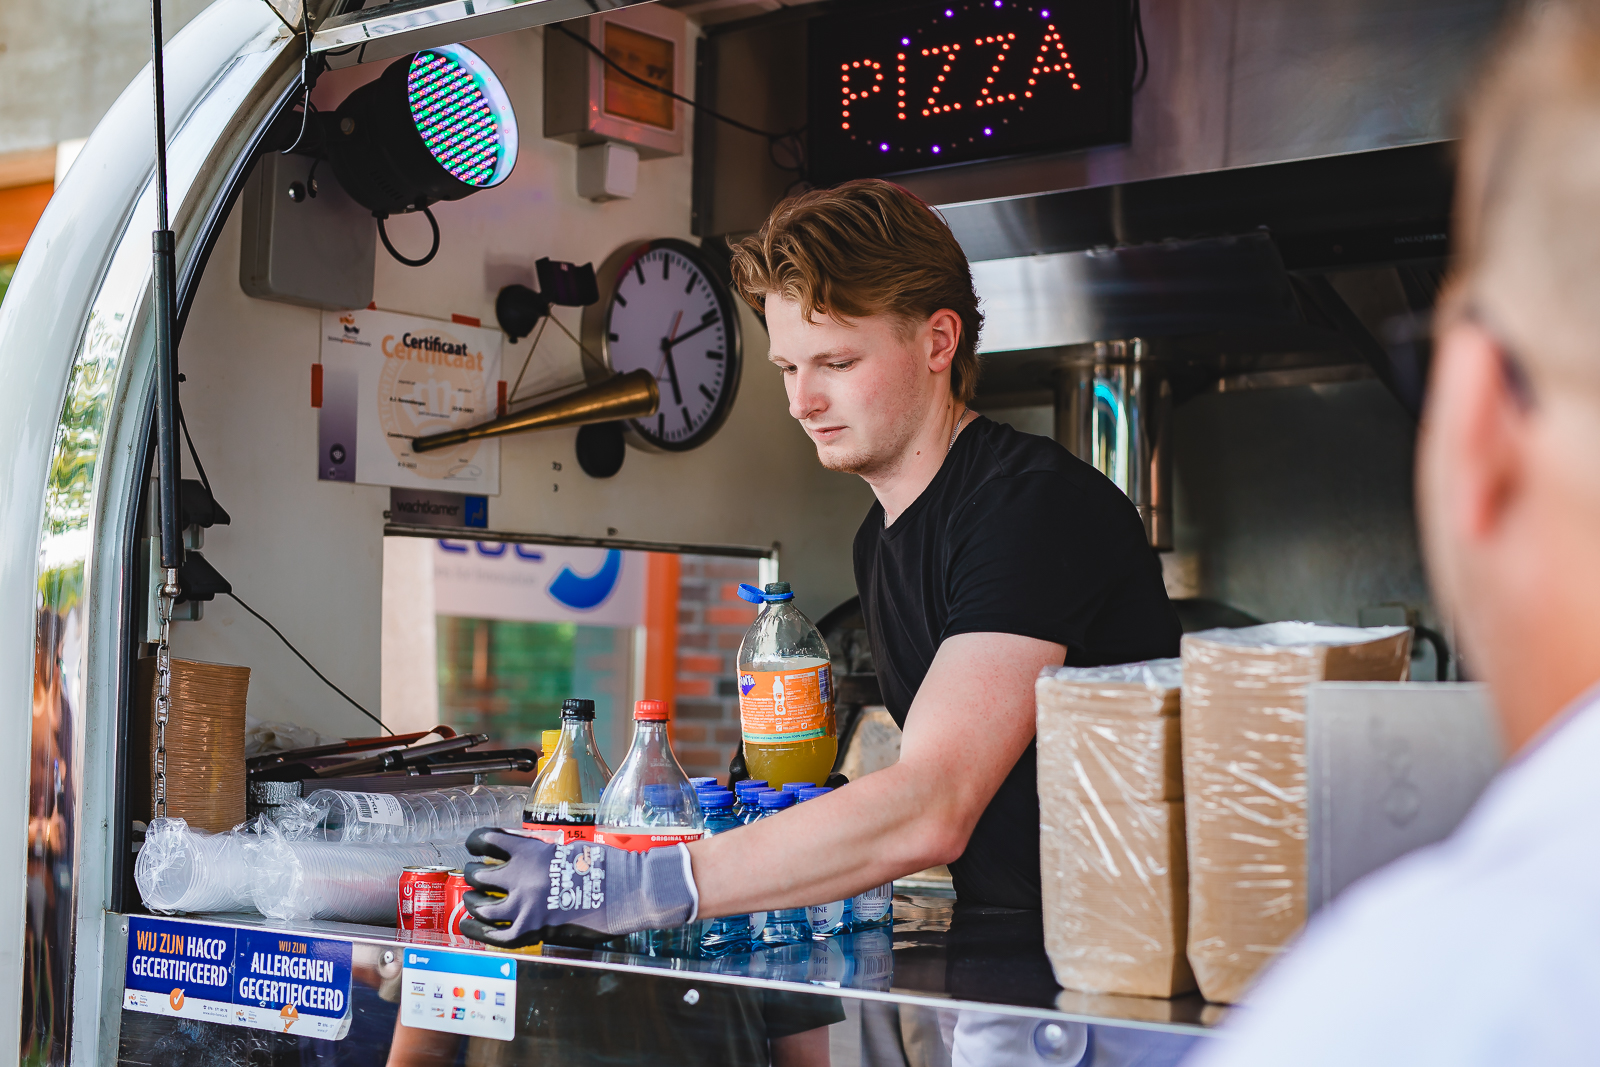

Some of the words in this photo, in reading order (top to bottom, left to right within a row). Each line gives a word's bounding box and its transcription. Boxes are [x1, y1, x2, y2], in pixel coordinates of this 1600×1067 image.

[841, 24, 1081, 130] PIZZA
[402, 332, 468, 357] Certificaat
[396, 500, 460, 516] wachtkamer
[567, 831, 586, 839] 1.5L
[547, 844, 564, 910] MaxiFlex
[812, 906, 828, 914] EINE
[136, 930, 157, 952] WIJ
[158, 932, 184, 955] ZIJN
[187, 936, 227, 961] HACCP
[278, 940, 291, 952] WIJ
[292, 942, 307, 955] ZIJN
[132, 955, 228, 987] GECERTIFICEERD
[250, 951, 334, 983] ALLERGENEN
[239, 976, 344, 1012] GECERTIFICEERD
